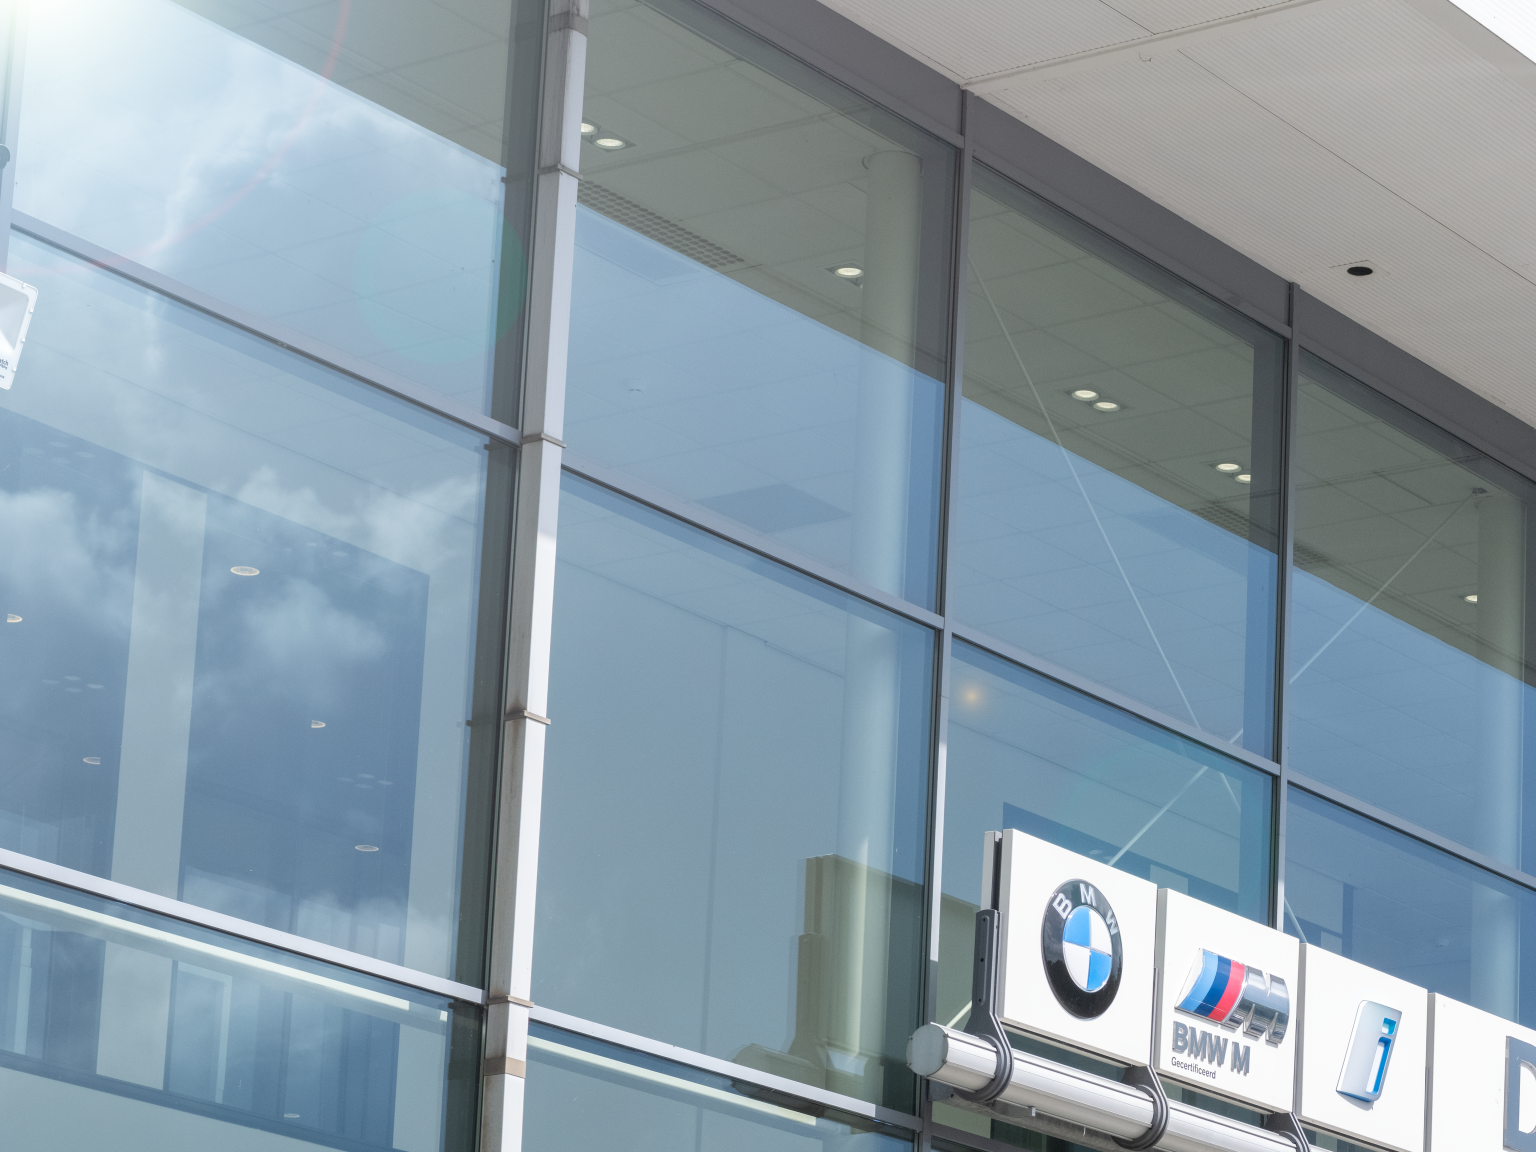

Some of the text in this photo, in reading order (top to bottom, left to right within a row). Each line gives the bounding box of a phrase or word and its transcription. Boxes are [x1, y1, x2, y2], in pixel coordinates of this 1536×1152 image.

[1052, 883, 1119, 936] BMW
[1171, 1057, 1216, 1079] Gecertificeerd
[1172, 1021, 1250, 1077] BMW M
